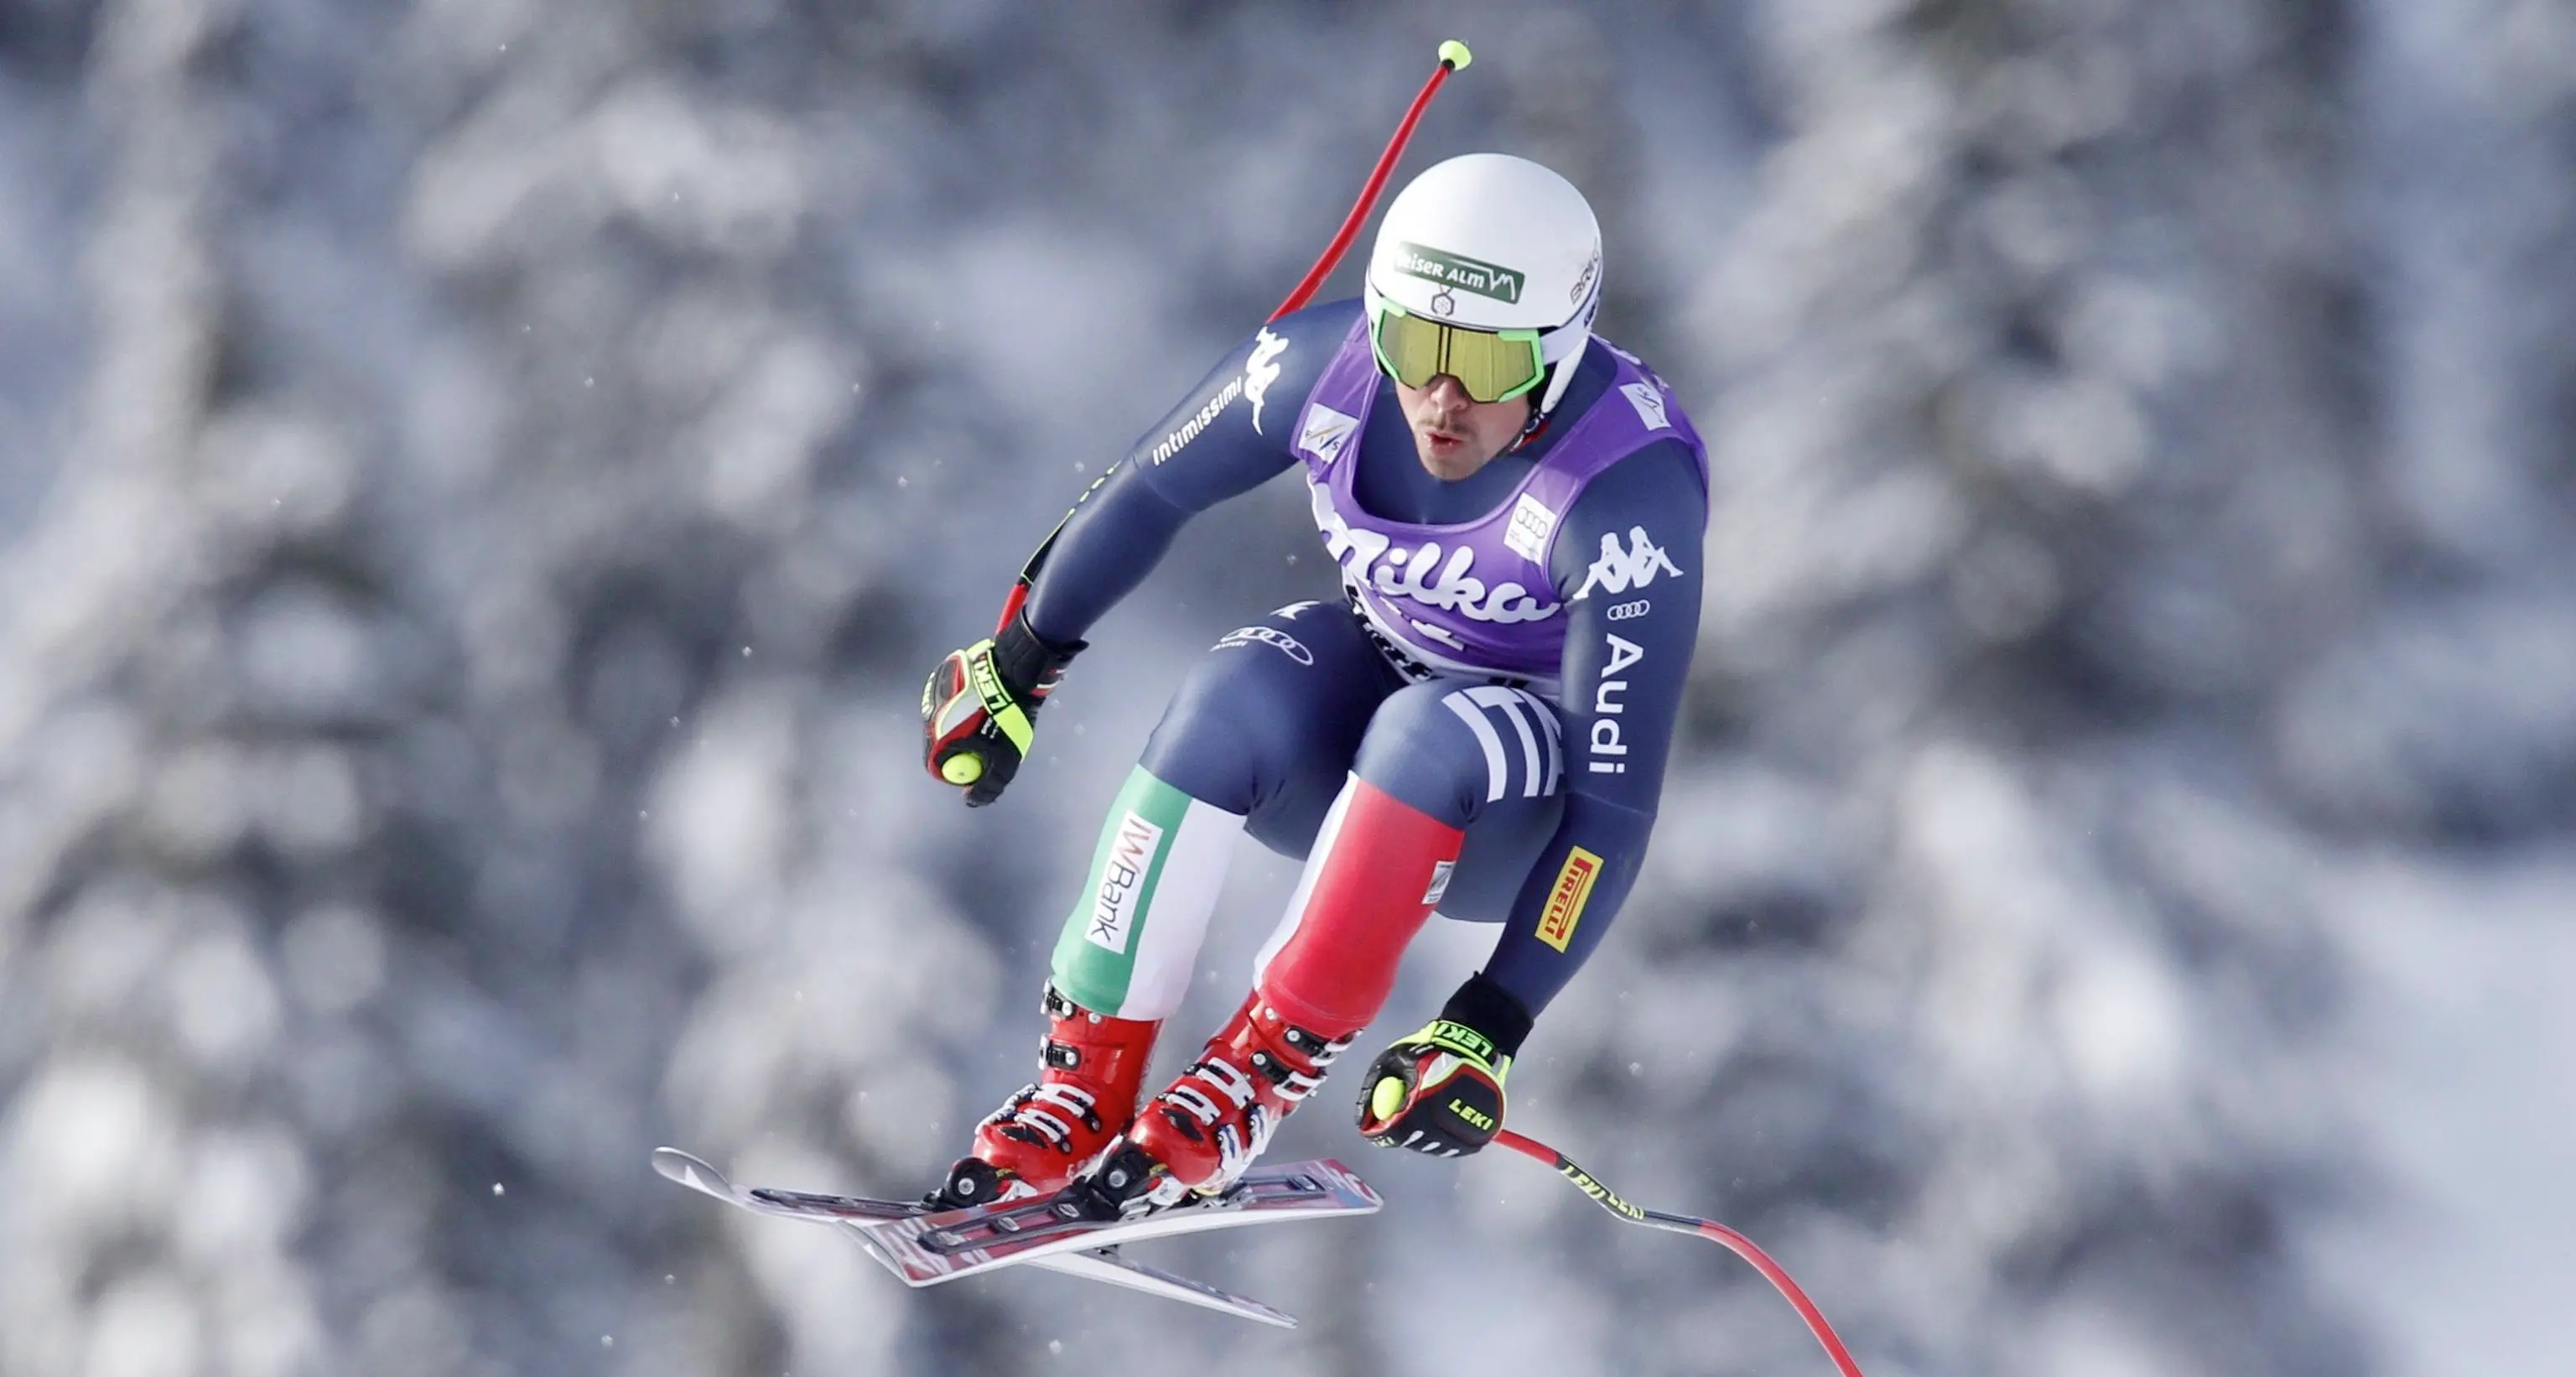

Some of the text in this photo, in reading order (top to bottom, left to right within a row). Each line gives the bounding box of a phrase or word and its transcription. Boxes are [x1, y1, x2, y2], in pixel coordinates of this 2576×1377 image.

[1306, 474, 1561, 624] Milka
[973, 659, 1010, 711] LEKI
[1589, 632, 1644, 774] Audi
[1091, 818, 1152, 943] IWBank
[1545, 856, 1593, 940] PIRELLI
[1434, 1023, 1494, 1057] LEKI
[1448, 1099, 1493, 1130] LEKI
